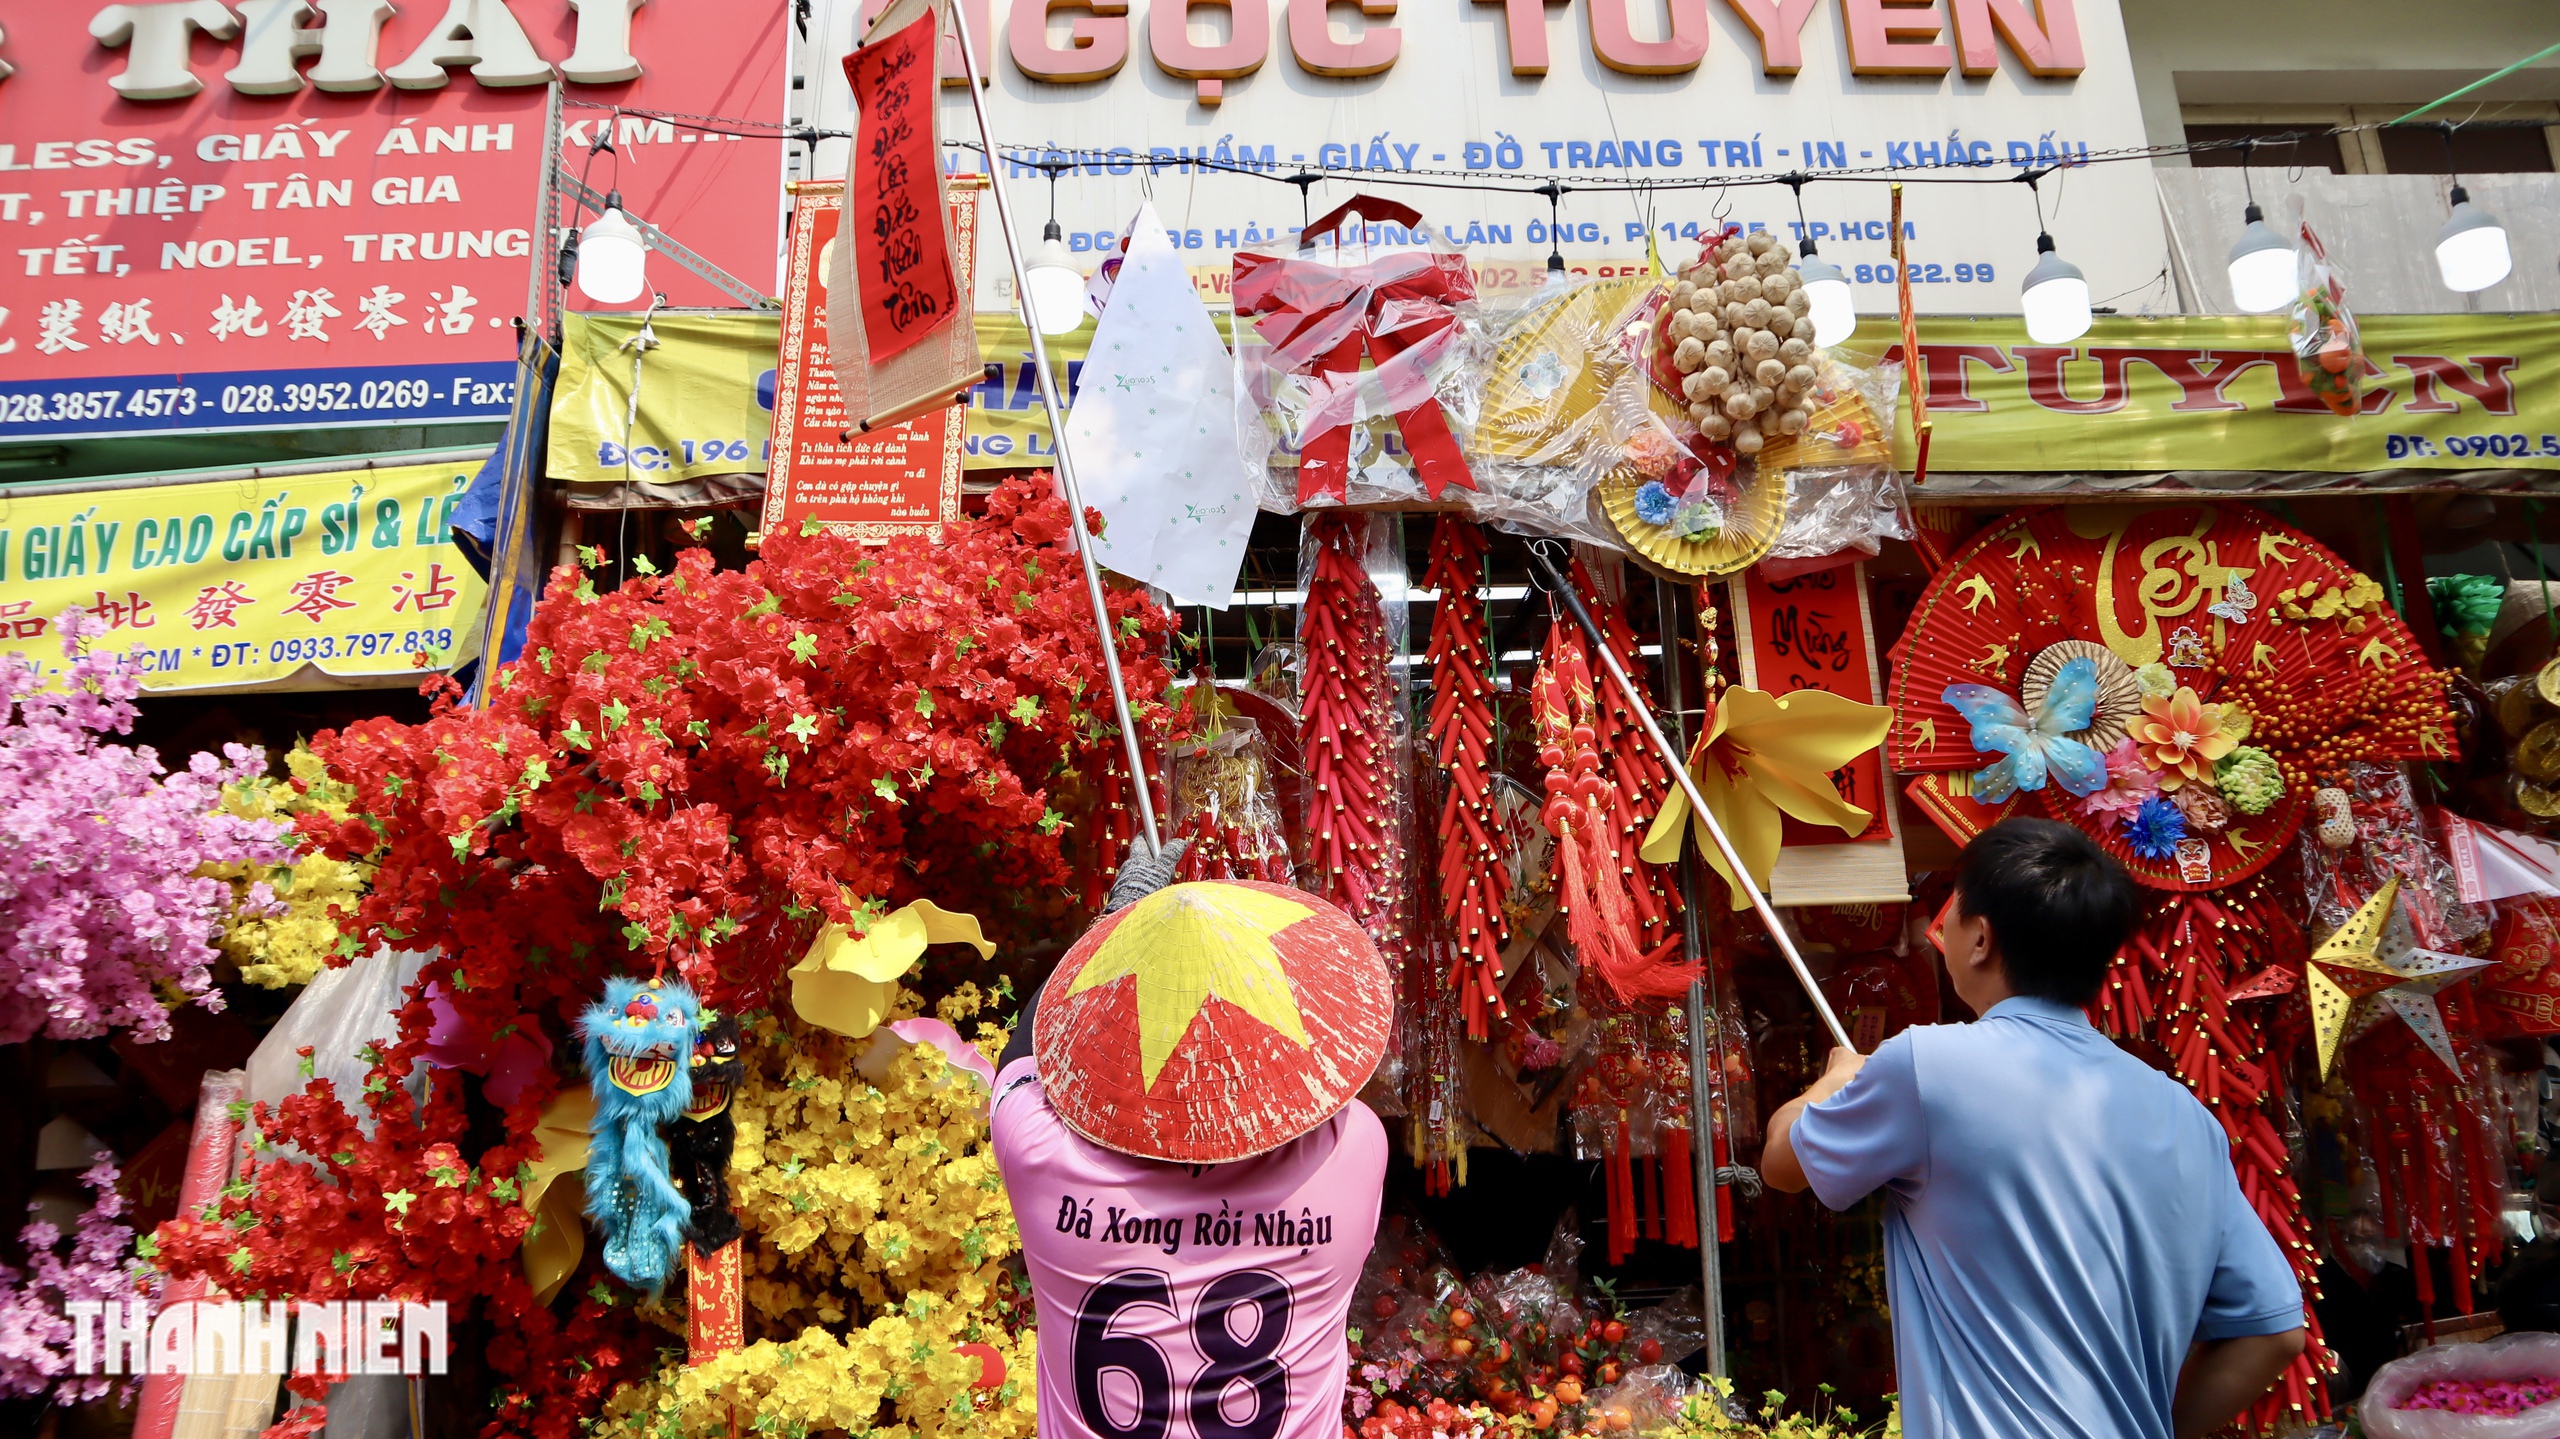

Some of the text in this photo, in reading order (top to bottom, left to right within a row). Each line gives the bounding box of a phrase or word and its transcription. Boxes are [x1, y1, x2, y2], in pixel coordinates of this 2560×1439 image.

[0, 138, 173, 171] LESS,
[196, 118, 351, 162] GIẤY
[375, 118, 514, 156] ÁNH
[1149, 134, 1276, 176] PHẨM
[1319, 131, 1419, 171] GIẤY
[1463, 131, 1523, 169] ĐỒ
[1541, 140, 1683, 169] TRANG
[1699, 132, 1762, 168] TRÍ
[1803, 140, 1848, 168] IN
[1886, 129, 1993, 168] KHẮC
[2007, 130, 2087, 168] DẤU
[60, 178, 226, 221] THIỆP
[243, 172, 353, 211] TÂN
[371, 175, 462, 206] GIA
[1444, 222, 1512, 245] LÃN
[1527, 218, 1610, 246] ÔNG,
[1787, 221, 1916, 242] TP.HCM
[17, 234, 131, 278] TẾT,
[159, 236, 324, 270] NOEL,
[343, 229, 531, 263] TRUNG
[0, 387, 197, 423] 028.3857.4573
[222, 380, 430, 413] 028.3952.0269
[453, 378, 515, 406] Fax:
[680, 439, 749, 466] 196
[798, 455, 815, 466] Khi
[814, 442, 834, 454] thân
[2386, 434, 2441, 460] ĐT:
[904, 470, 915, 478] ra
[808, 493, 828, 504] trên
[861, 492, 889, 505] không
[890, 493, 906, 504] khi
[23, 506, 120, 581] GIẤY
[131, 514, 214, 570] CAO
[222, 492, 308, 562] CẤP
[320, 484, 365, 555] SỈ
[371, 497, 402, 549] &
[211, 643, 260, 668] ĐT:
[1055, 1195, 1333, 1256] Đá Xong Rồi Nhậu
[1069, 1266, 1296, 1439] 68
